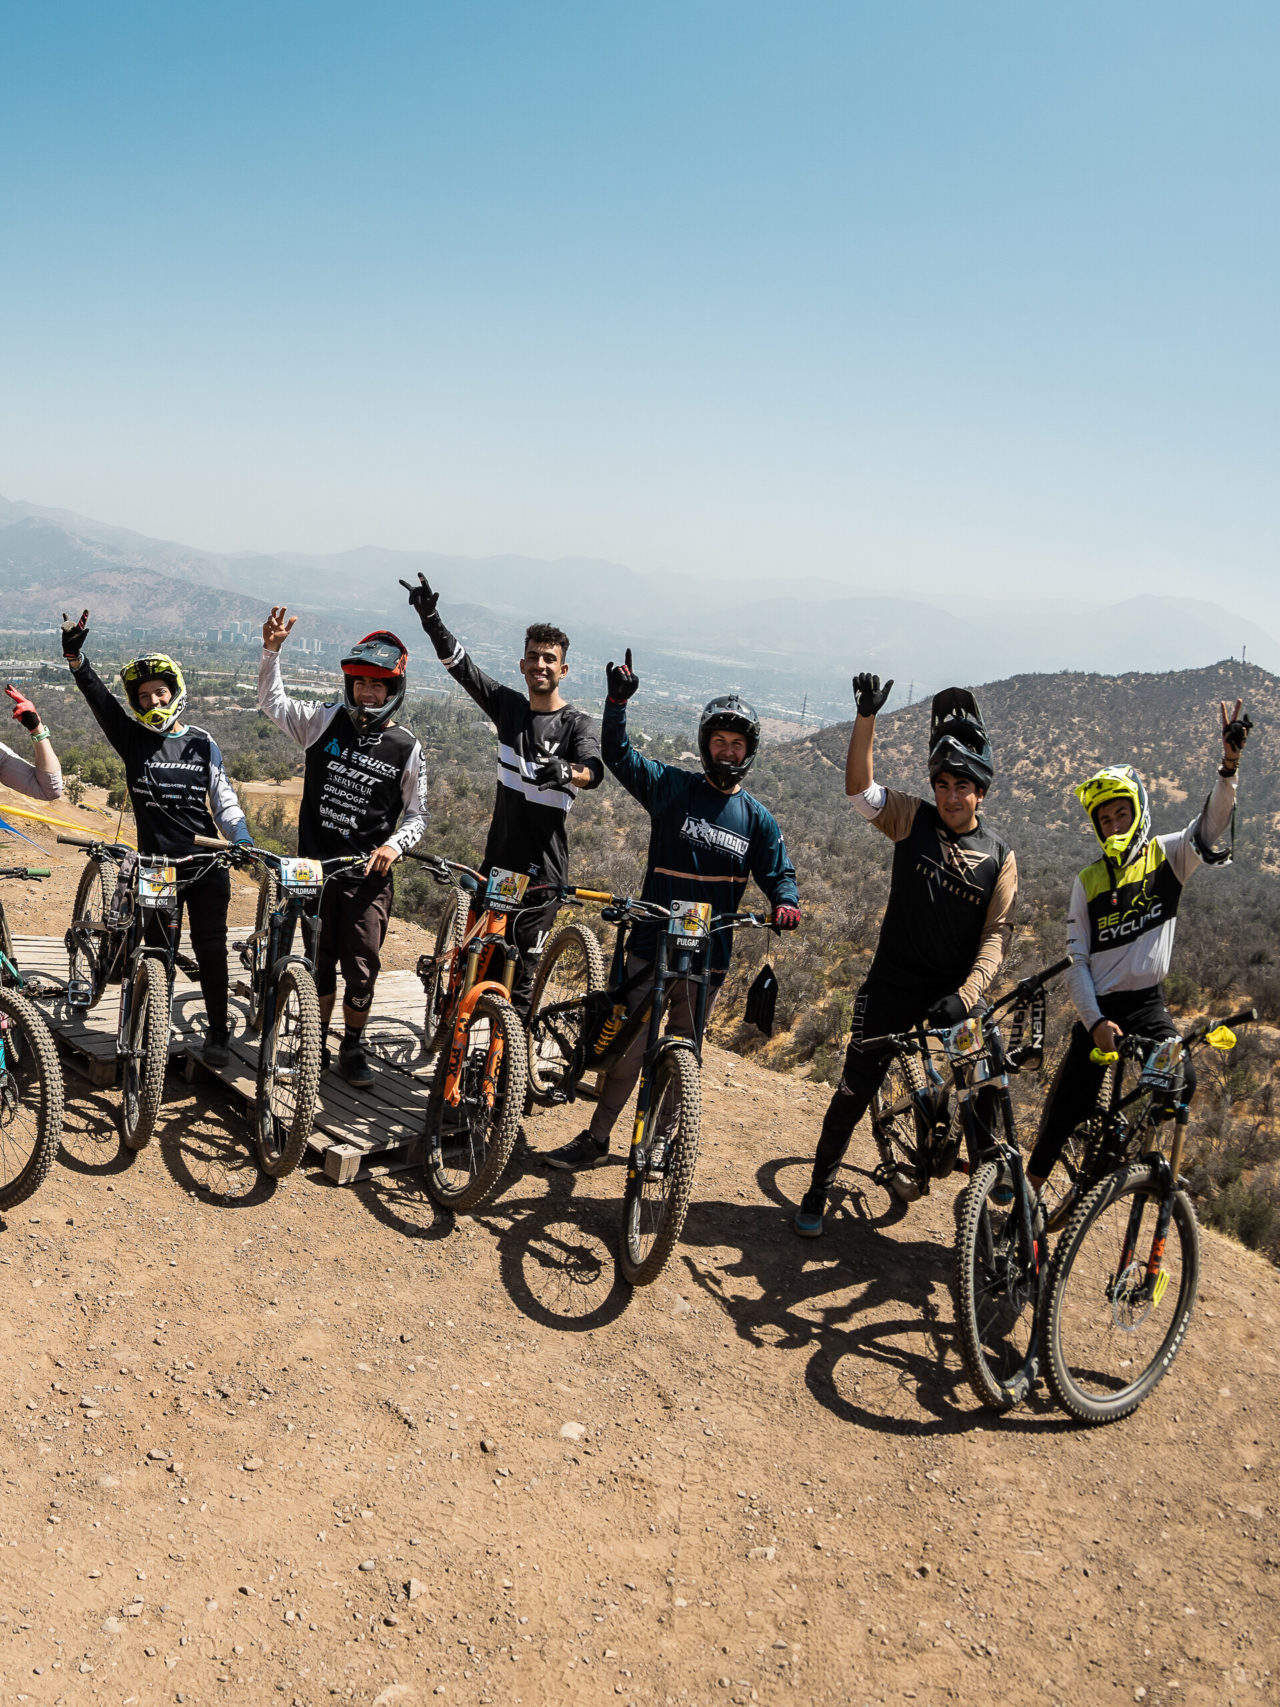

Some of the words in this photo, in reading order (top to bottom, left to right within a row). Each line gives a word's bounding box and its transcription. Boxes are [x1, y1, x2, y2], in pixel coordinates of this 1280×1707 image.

[327, 760, 384, 786] GIANT
[1097, 912, 1120, 931] BE
[1098, 903, 1162, 942] CYCLING
